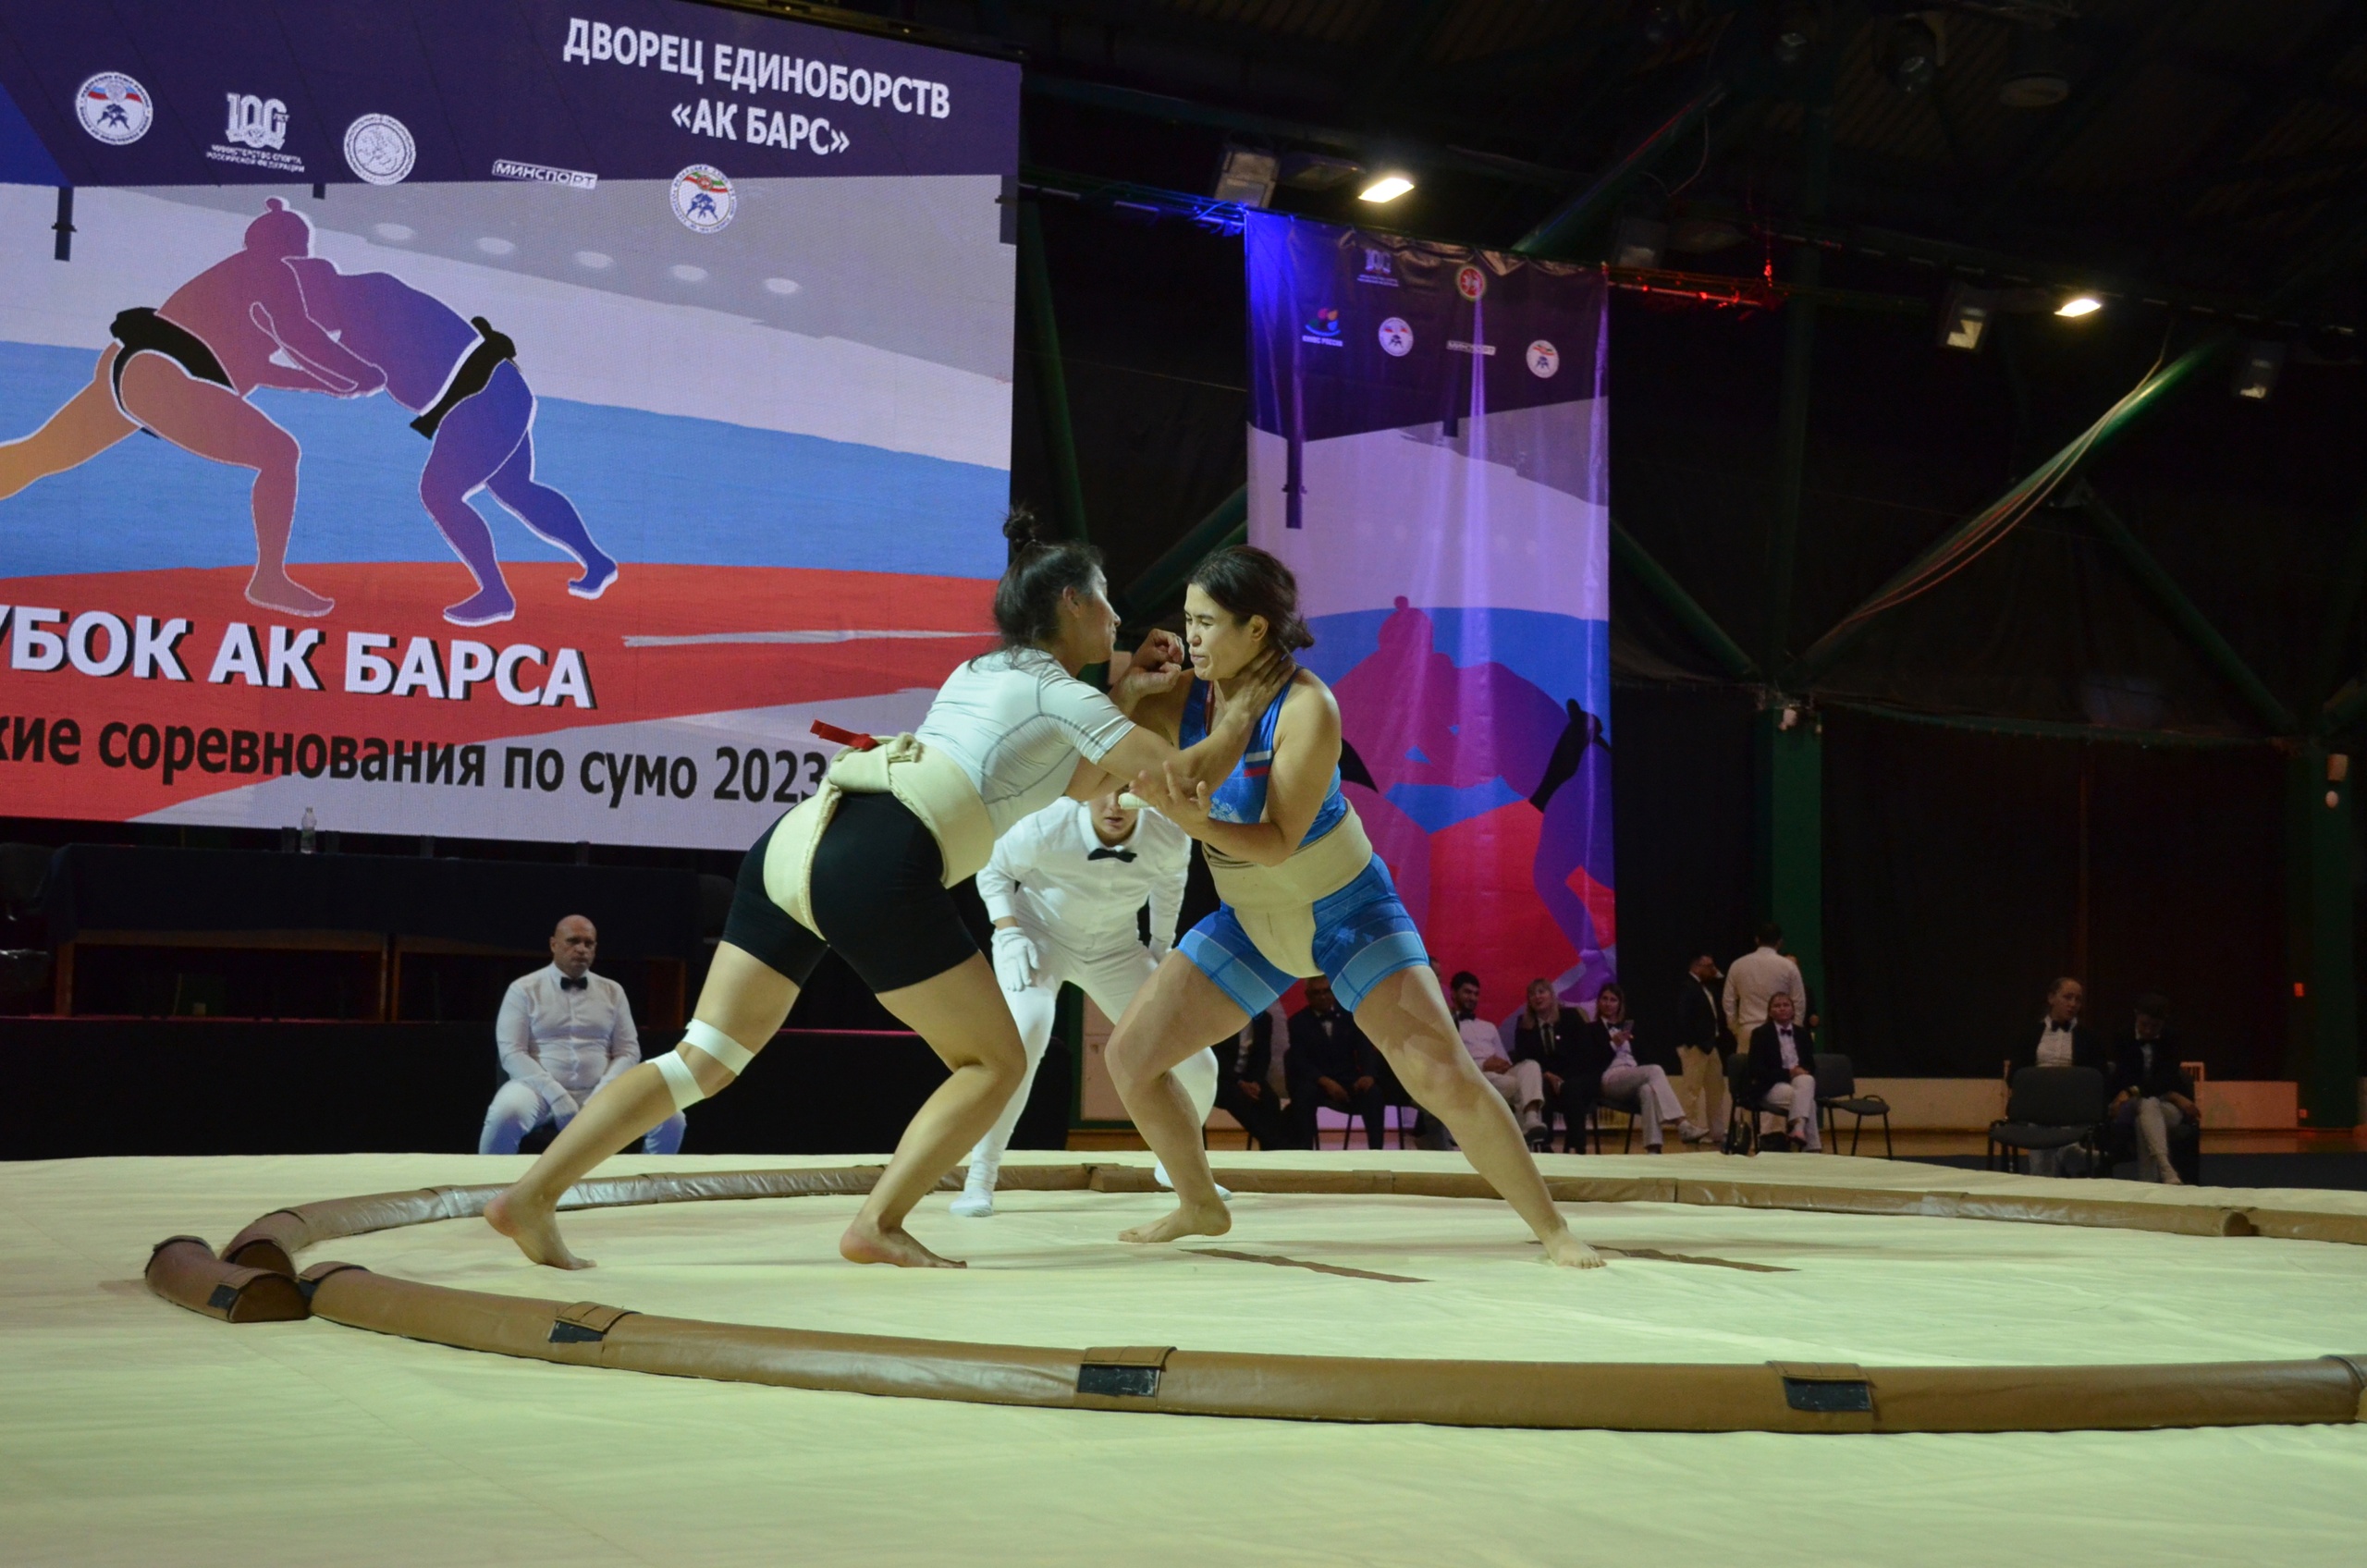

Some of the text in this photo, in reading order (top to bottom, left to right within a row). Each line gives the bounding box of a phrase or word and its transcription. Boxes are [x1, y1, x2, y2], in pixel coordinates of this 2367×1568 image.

[563, 18, 950, 118] ДВОРЕЦ ЕДИНОБОРСТВ
[671, 98, 850, 155] «АК БАРС»
[495, 162, 596, 188] МИНСПОРТ
[208, 622, 323, 691] АК
[345, 631, 597, 709] БАРСА
[98, 721, 485, 788] соревнования
[504, 746, 565, 792] по
[580, 750, 697, 809] сумо
[713, 745, 828, 803] 2023
